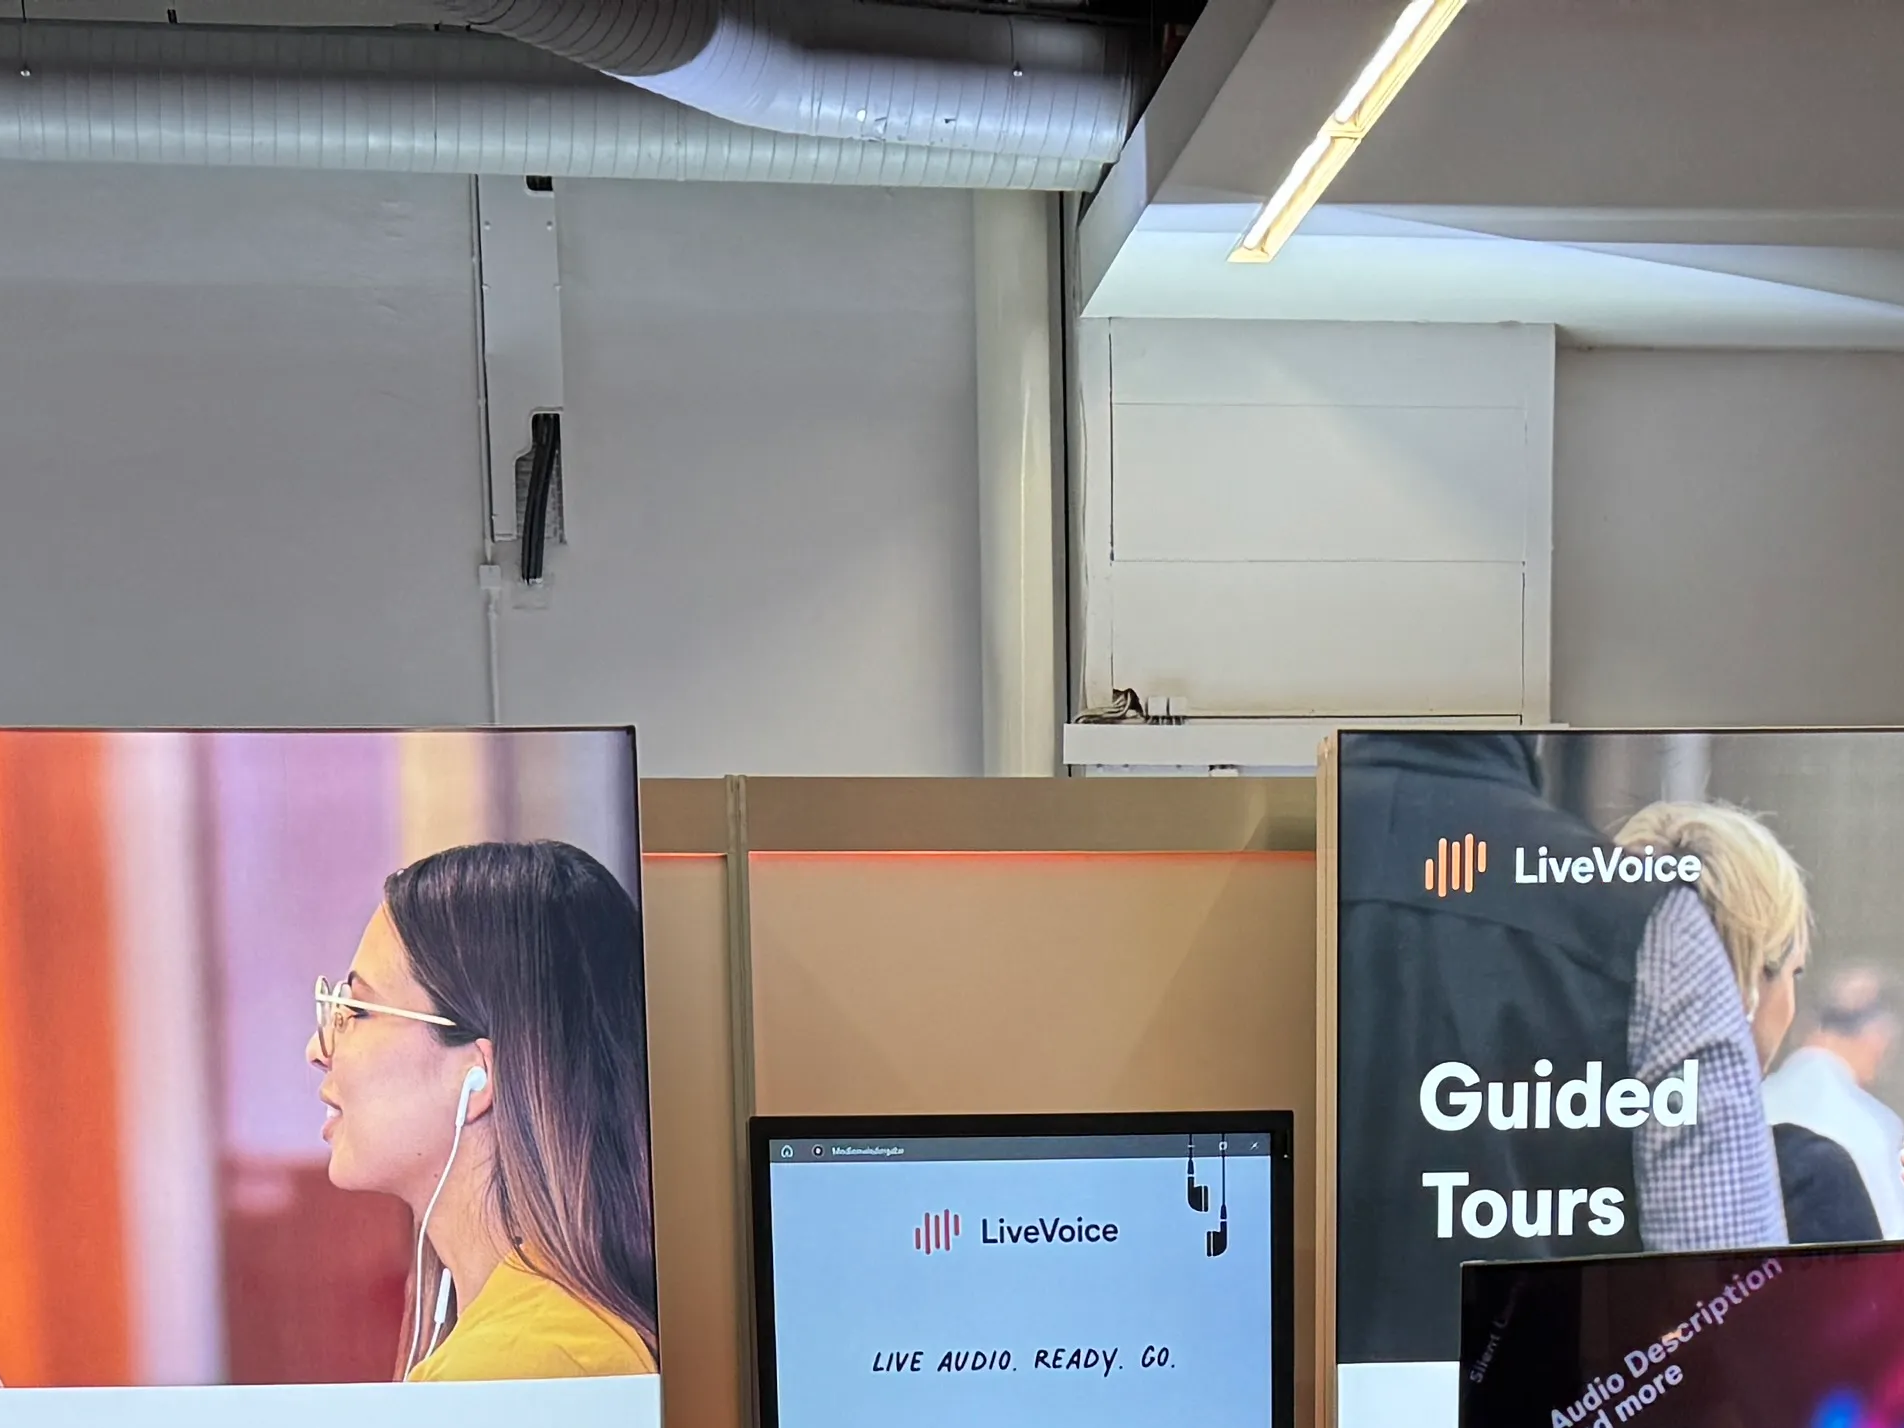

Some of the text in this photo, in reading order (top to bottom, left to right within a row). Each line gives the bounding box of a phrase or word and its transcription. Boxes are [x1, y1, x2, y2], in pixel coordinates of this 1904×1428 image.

[1514, 844, 1702, 884] LiveVoice
[1419, 1058, 1699, 1132] Guided
[981, 1216, 1119, 1245] LiveVoice
[1421, 1170, 1625, 1238] Tours
[1623, 1257, 1783, 1379] Description
[872, 1345, 1177, 1378] LIVE AUDIO. READY. GO.
[1614, 1364, 1684, 1423] more
